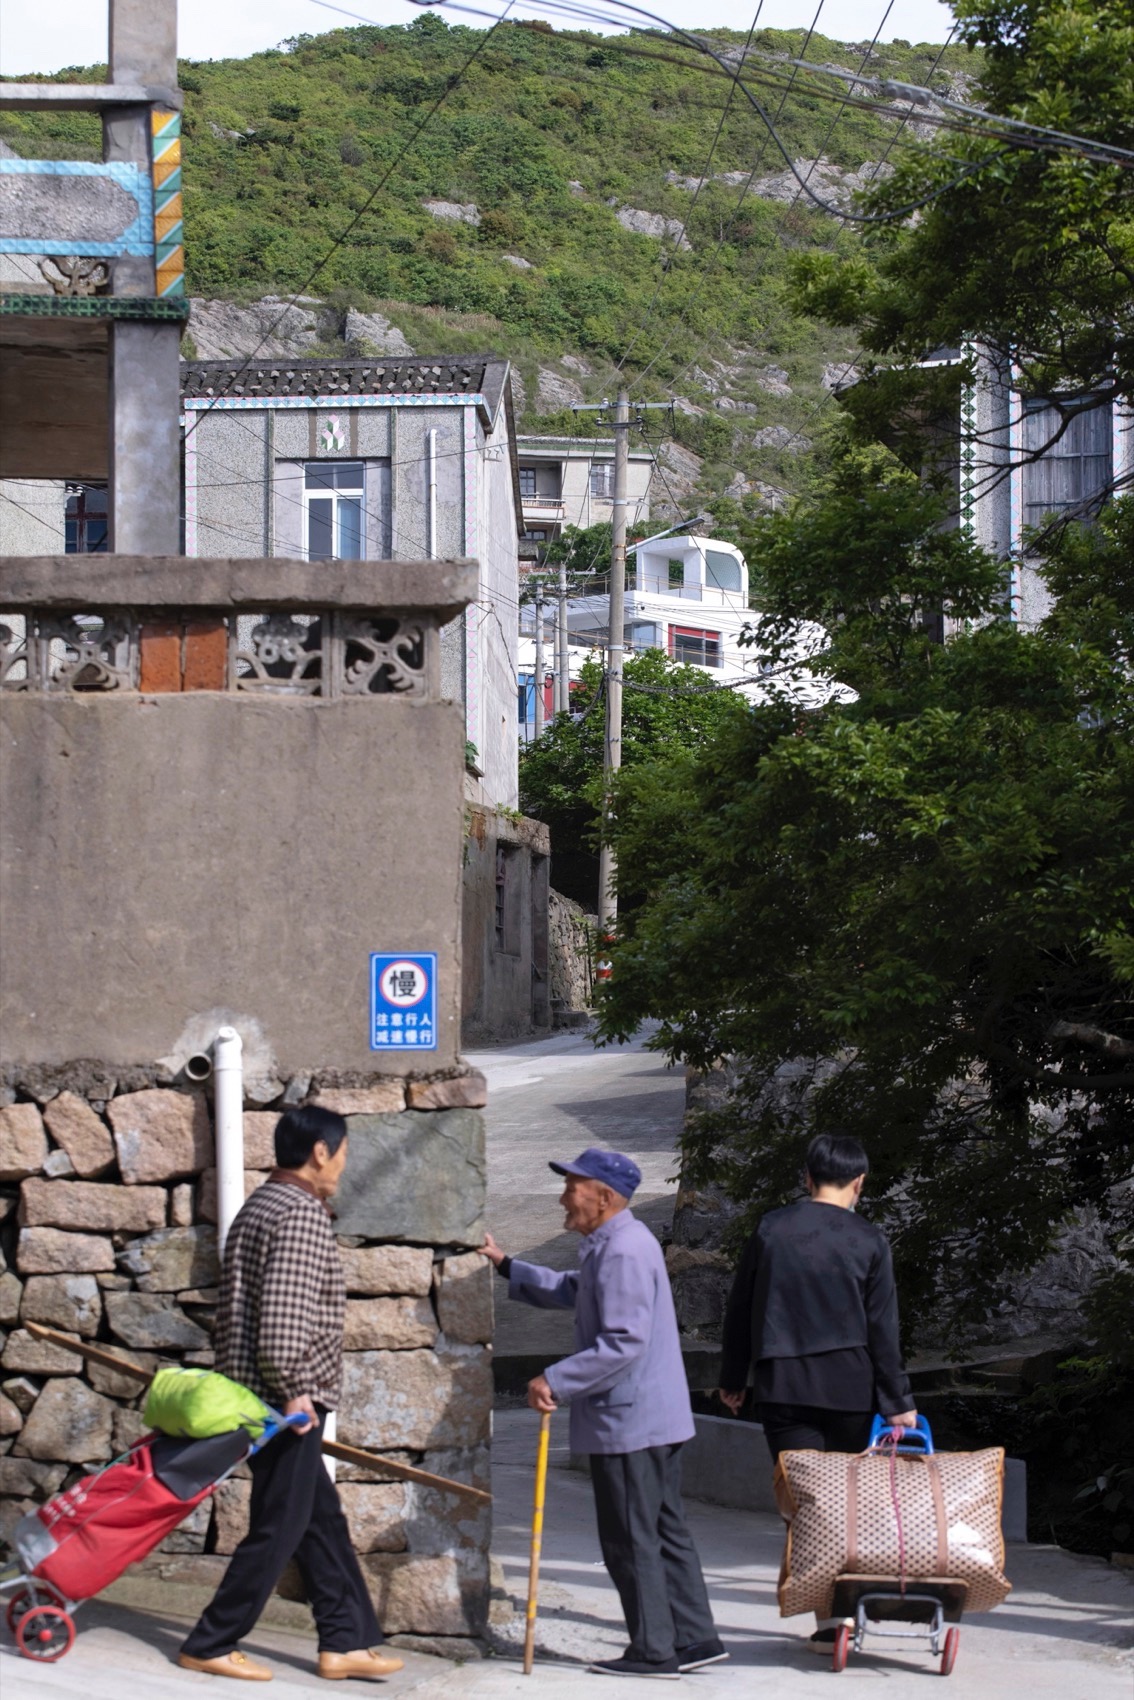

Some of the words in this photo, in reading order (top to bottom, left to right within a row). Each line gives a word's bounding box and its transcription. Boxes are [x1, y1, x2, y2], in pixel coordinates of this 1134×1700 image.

[389, 970, 417, 997] 慢
[376, 1013, 432, 1026] 注意行人
[376, 1030, 432, 1043] 减速慢行
